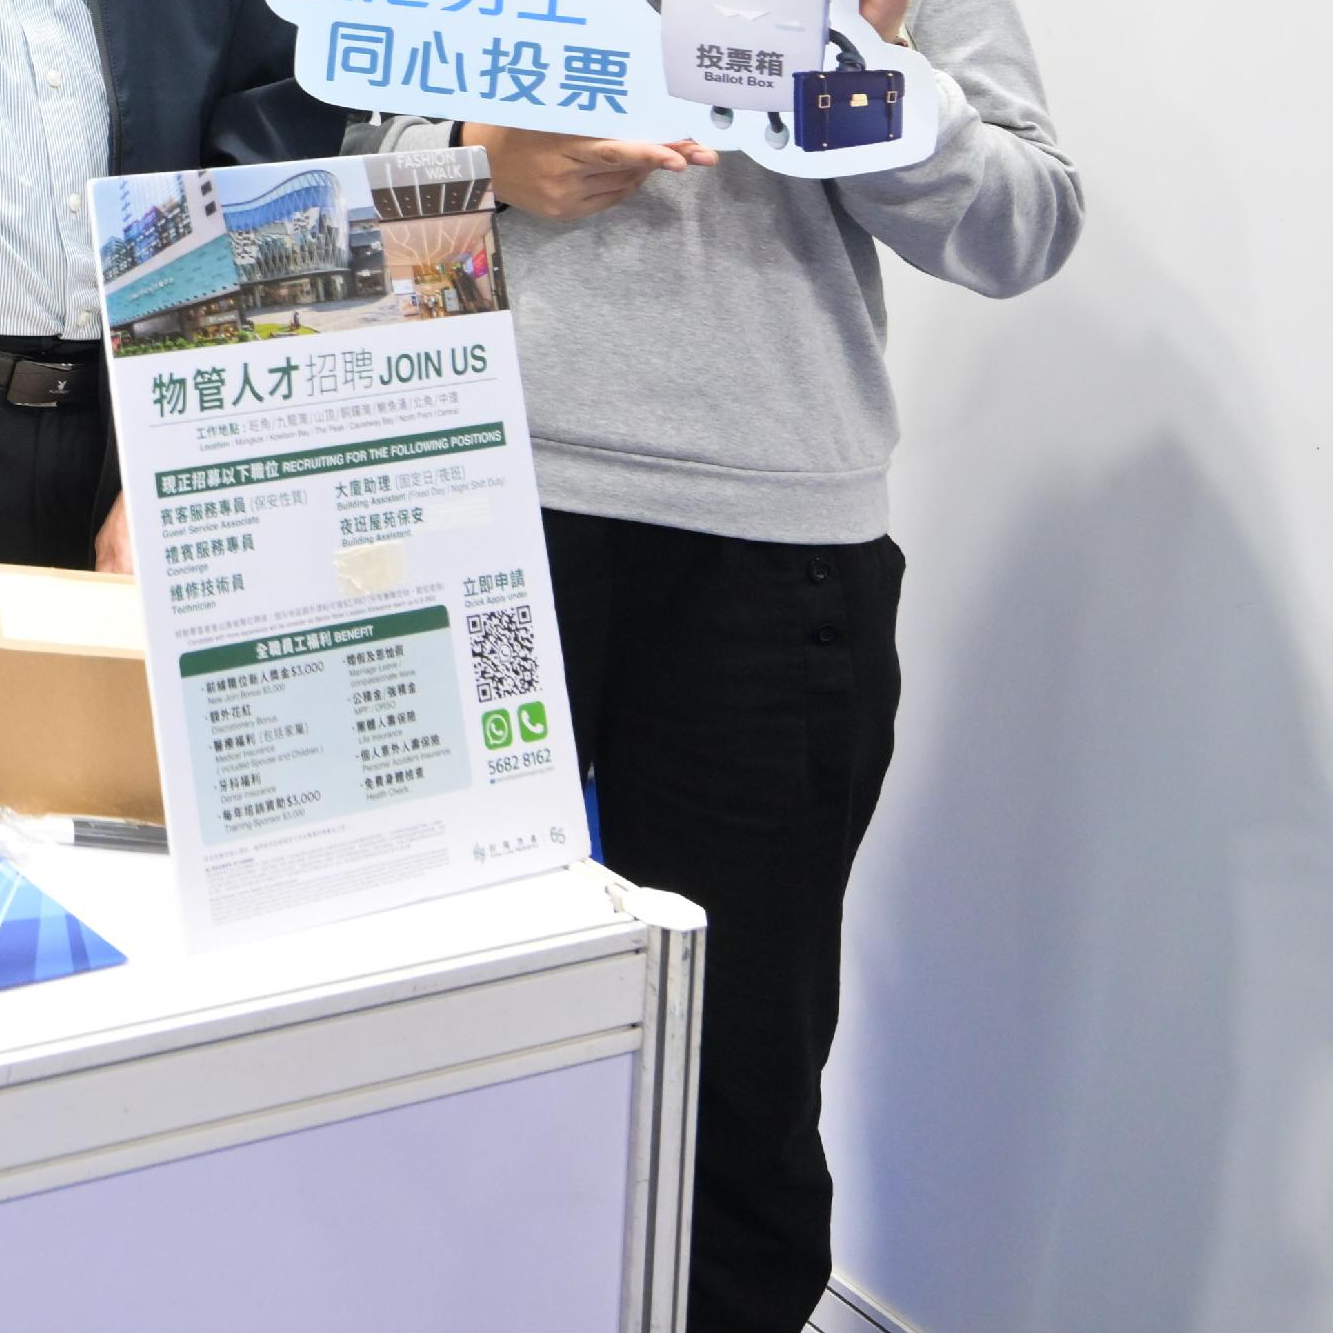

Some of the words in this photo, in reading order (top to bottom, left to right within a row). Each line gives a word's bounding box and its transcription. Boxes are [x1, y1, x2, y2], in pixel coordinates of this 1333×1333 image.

[326, 21, 631, 115] 同心投票
[696, 44, 785, 77] 投票箱
[704, 71, 743, 85] Ballot
[747, 76, 774, 89] Box
[397, 150, 456, 169] FASHION
[427, 163, 462, 180] WALK
[379, 350, 442, 386] JOIN
[451, 344, 487, 377] US
[283, 451, 344, 474] RECRUITING
[346, 450, 367, 464] FOR
[370, 447, 389, 460] THE
[392, 438, 449, 456] FOLLOWING
[451, 429, 502, 447] POSITIONS
[161, 497, 246, 527] 賓客服務專員
[337, 499, 369, 511] Building
[372, 493, 406, 504] Assistant
[162, 525, 186, 538] Guest
[189, 520, 219, 535] Service
[221, 516, 260, 529] Associate
[340, 507, 425, 536] 夜班屋苑保安
[165, 533, 255, 564] 禮賓服務專員
[342, 535, 374, 547] Building
[167, 563, 209, 577] Concierge
[463, 568, 525, 597] 立即申請
[170, 573, 245, 602] 維修技術員
[171, 600, 216, 614] Technician
[334, 624, 374, 643] BENEFIT
[488, 755, 519, 775] 5682
[523, 748, 551, 767] 8162
